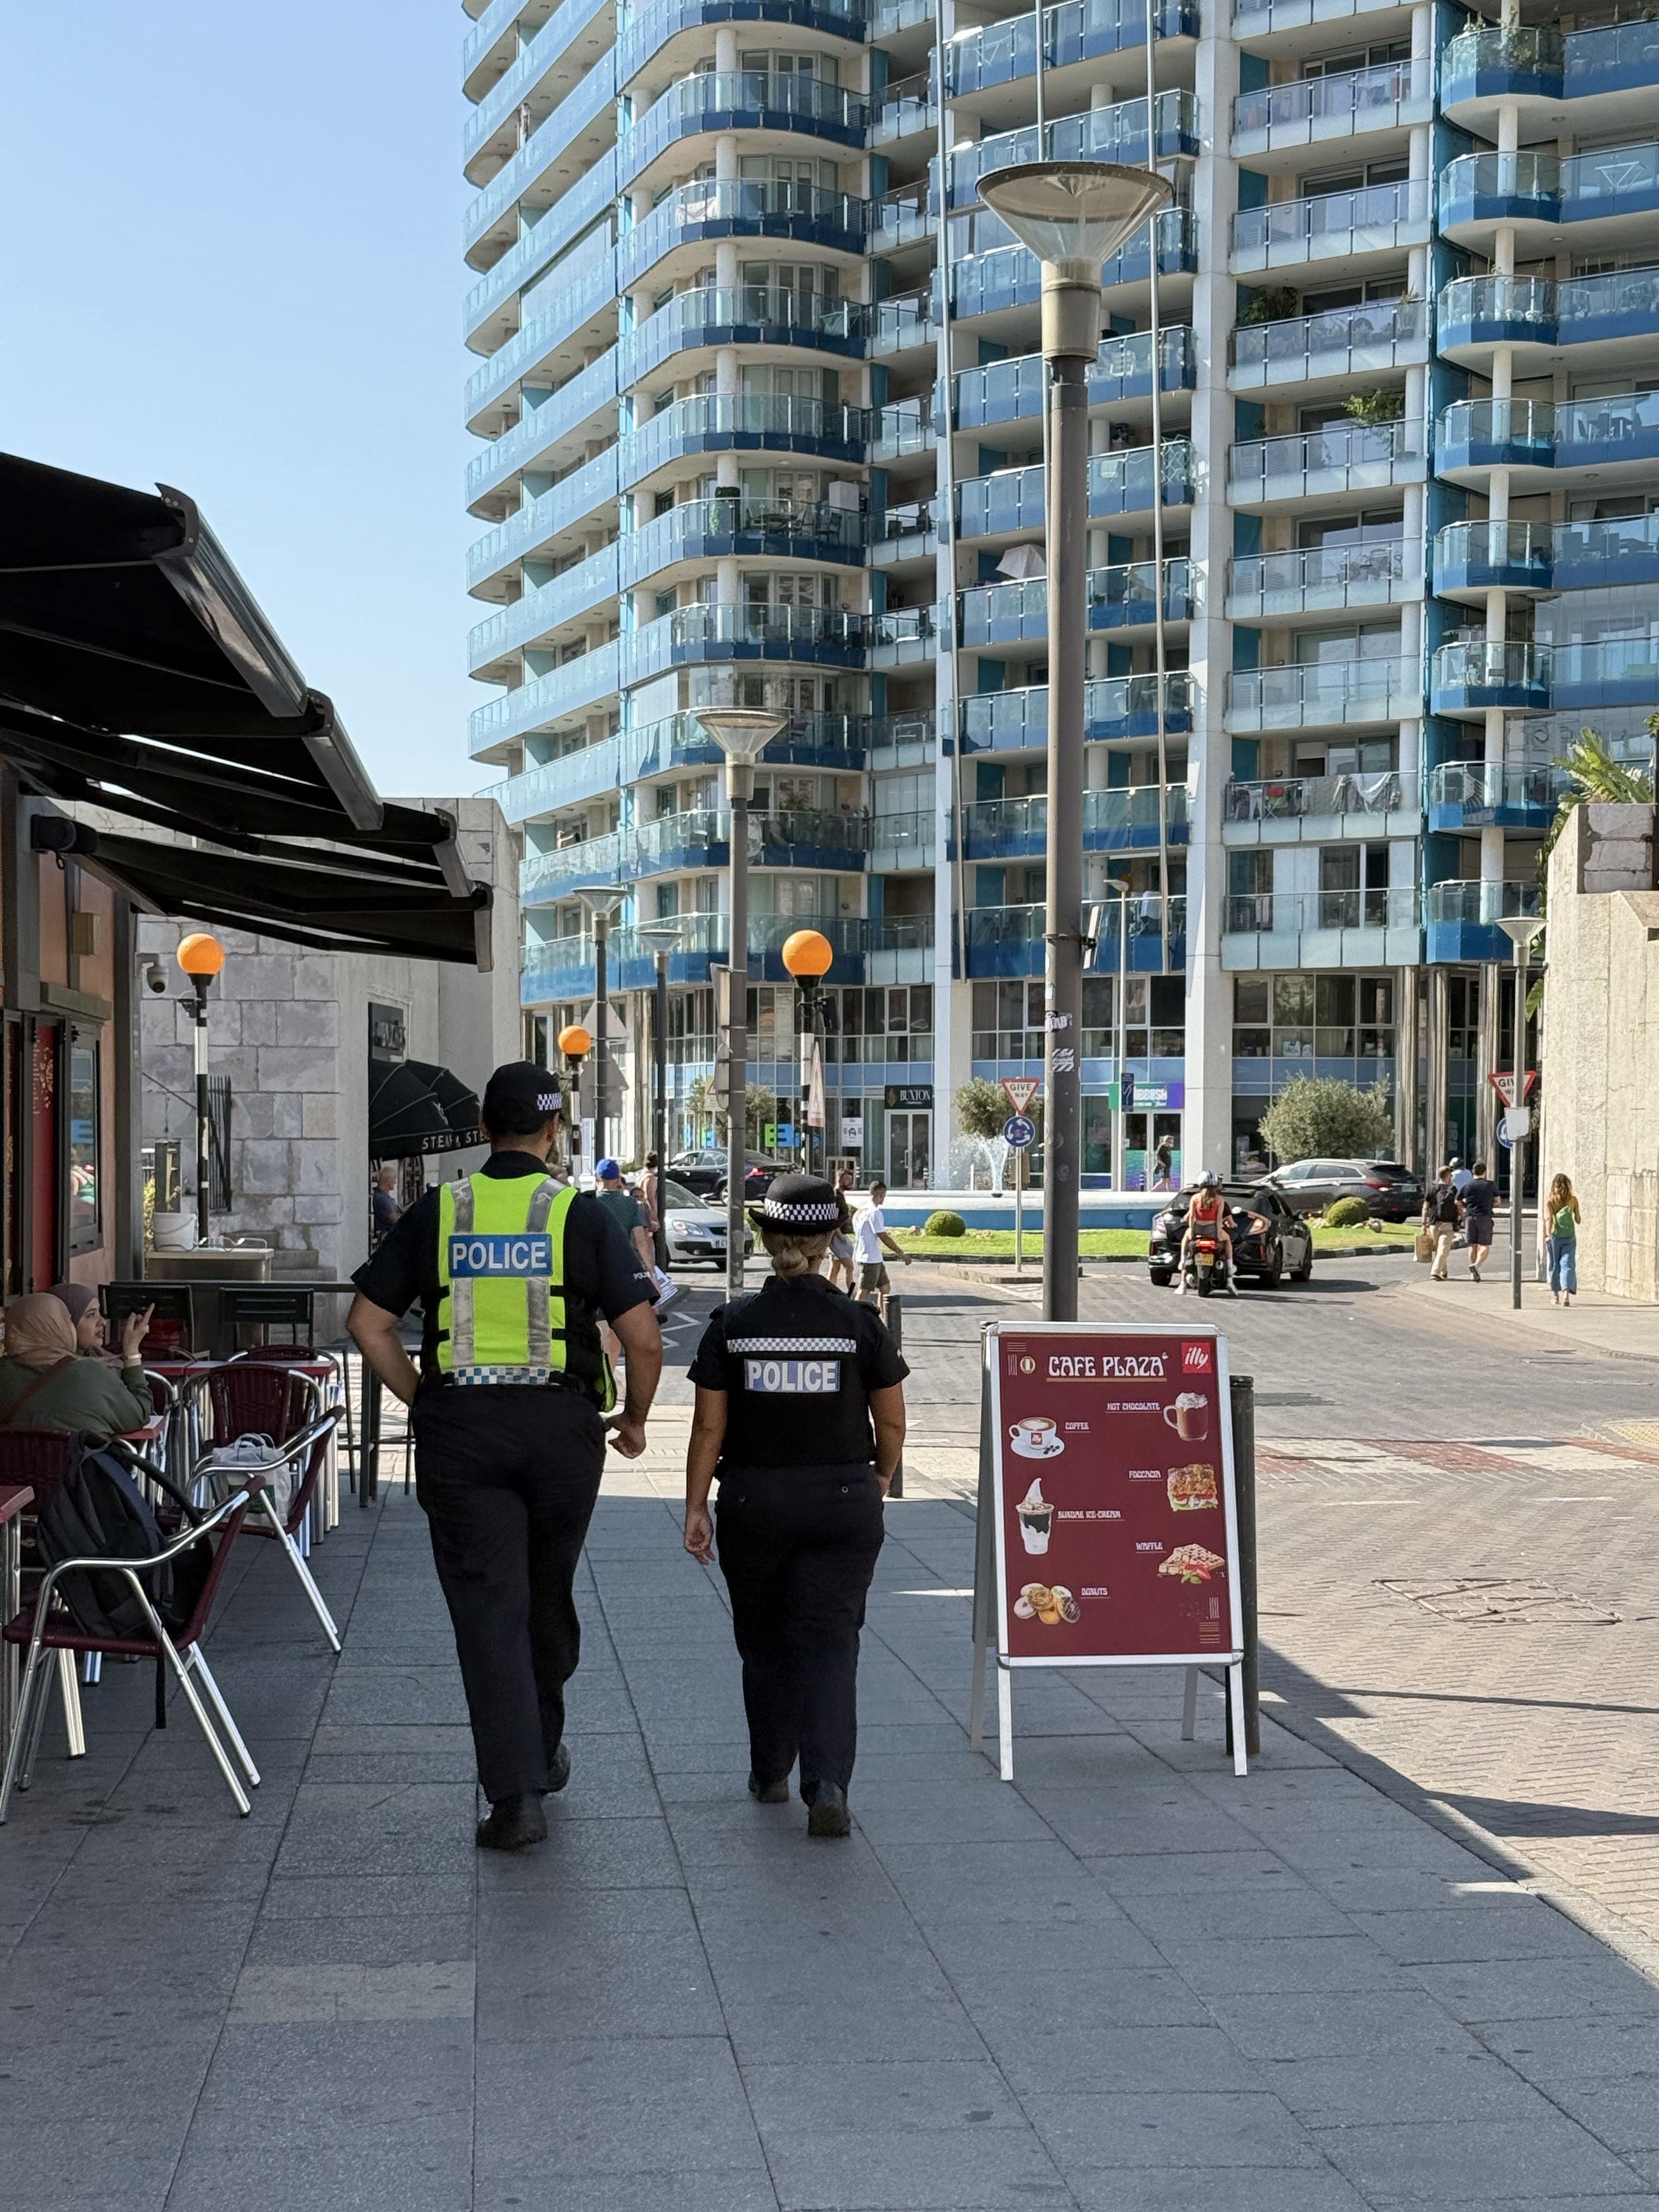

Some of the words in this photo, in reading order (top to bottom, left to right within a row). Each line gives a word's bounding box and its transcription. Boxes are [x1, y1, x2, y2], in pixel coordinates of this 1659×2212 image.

[1010, 1083, 1031, 1091] GIVE
[1498, 1078, 1514, 1088] GI
[900, 1090, 931, 1101] BUXTON
[452, 1241, 547, 1270] POLICE
[1185, 1346, 1209, 1370] illy
[1048, 1356, 1096, 1376] CAFE
[1102, 1356, 1164, 1376] PLAZA
[748, 1361, 836, 1391] POLICE
[1107, 1402, 1121, 1410] HOT
[1122, 1402, 1161, 1410] CHOCOLATE
[1065, 1422, 1090, 1430] COFFEE
[1057, 1511, 1084, 1519] SUNDAE
[1135, 1542, 1163, 1551] WAFFLE
[1081, 1587, 1108, 1596] DONUTS
